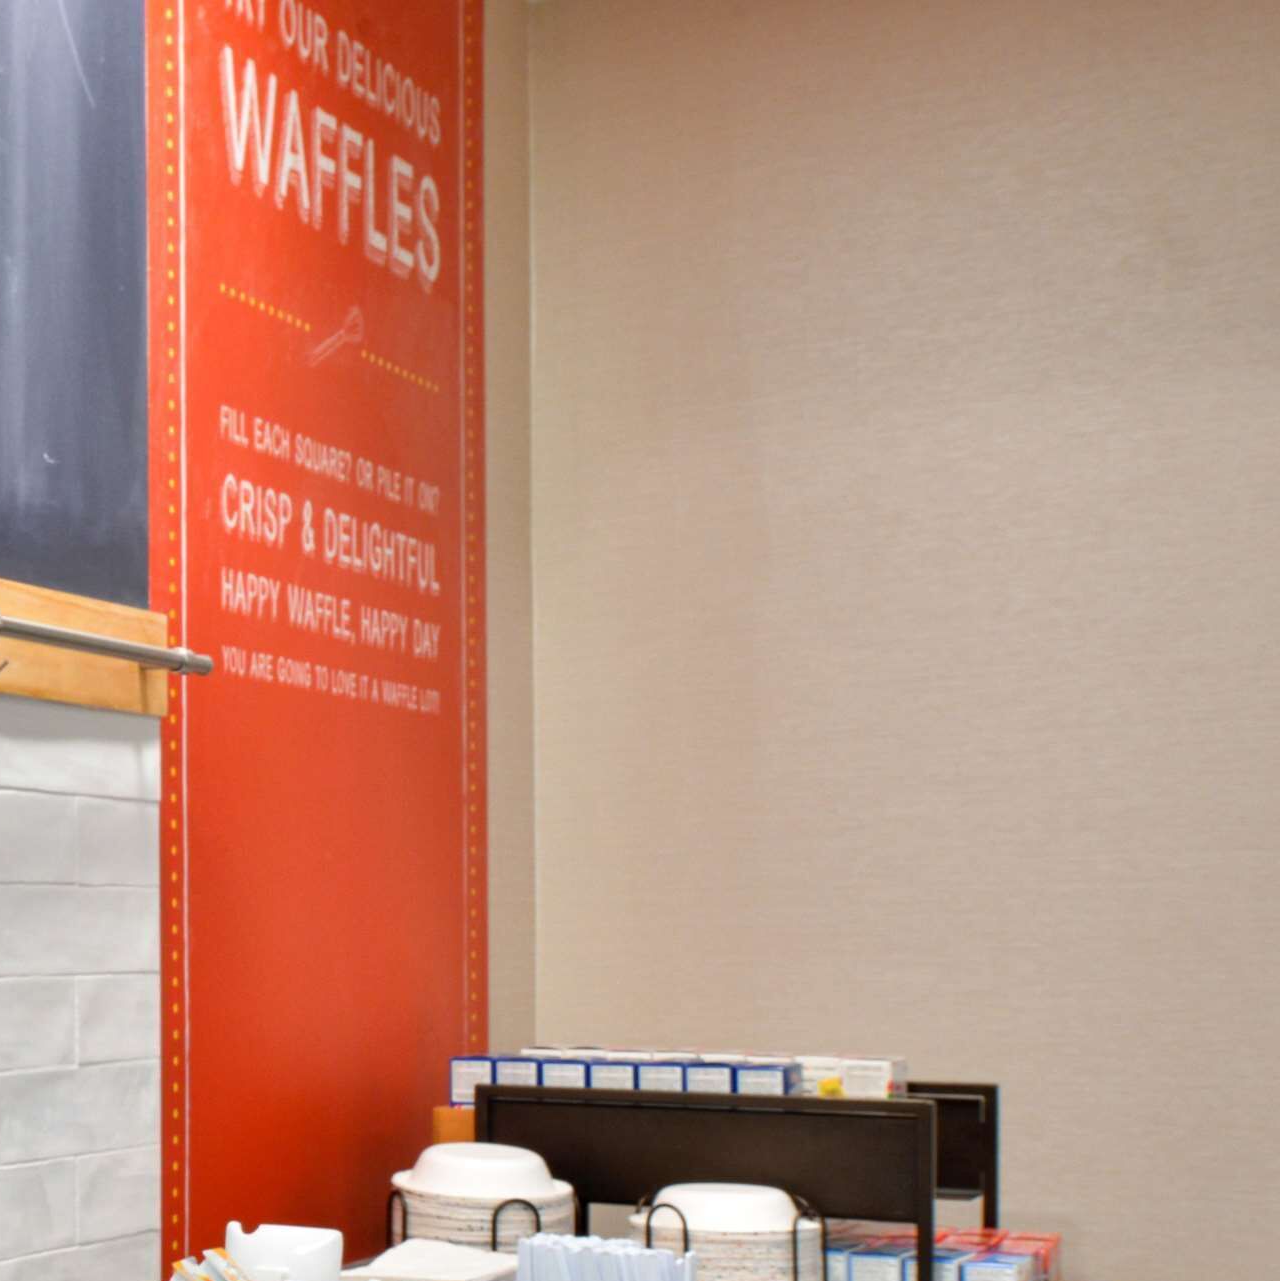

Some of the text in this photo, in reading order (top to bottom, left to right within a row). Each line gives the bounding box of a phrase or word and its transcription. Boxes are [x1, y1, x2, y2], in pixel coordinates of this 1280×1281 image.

[280, 0, 440, 145] OUR DELICIOUS
[220, 44, 440, 294] WAFFLES
[220, 404, 249, 446] FILL
[253, 416, 290, 462] EACH
[295, 432, 353, 483] SQUARE?
[356, 456, 374, 493] OR
[377, 465, 401, 502] PILE
[221, 472, 440, 596] CRISP & DELIGHTFUL
[220, 566, 440, 659] HAPPY WAFFLE, HAPPY DAY
[222, 645, 246, 677] YOU
[250, 651, 274, 682] ARE
[277, 655, 312, 690] GOING
[314, 664, 329, 692] TO
[331, 668, 357, 699] LOVE
